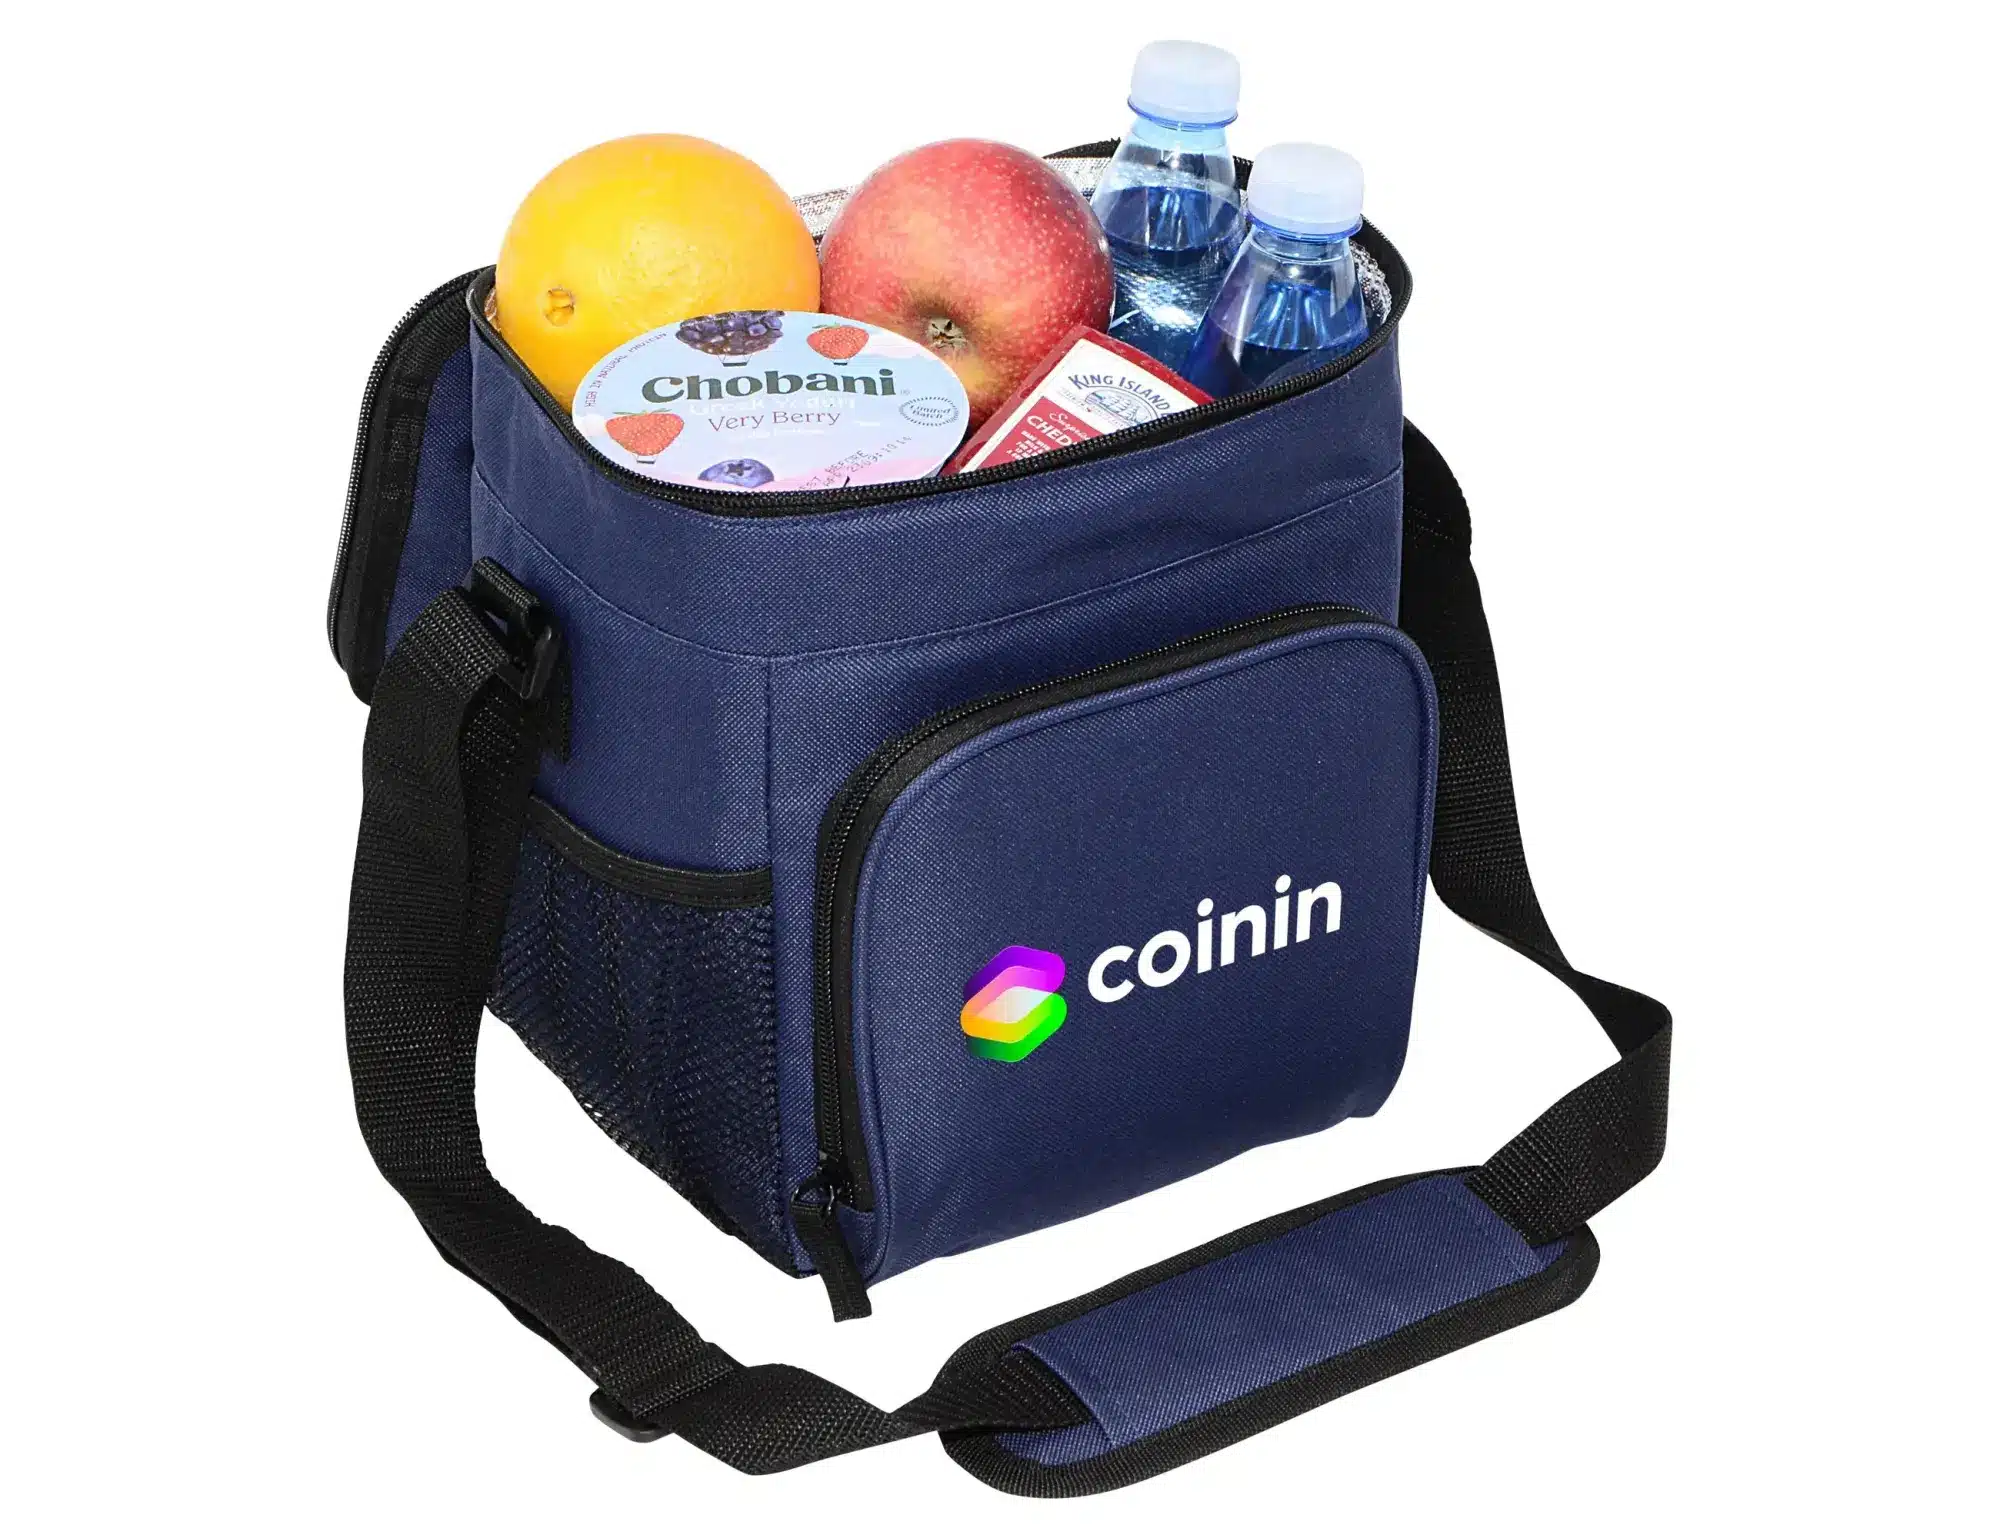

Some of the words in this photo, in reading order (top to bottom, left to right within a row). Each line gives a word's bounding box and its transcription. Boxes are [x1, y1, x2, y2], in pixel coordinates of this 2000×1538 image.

[641, 368, 897, 403] Chobani
[1068, 374, 1114, 390] KING
[1119, 376, 1170, 412] ISLAND
[708, 415, 764, 432] Very
[773, 411, 841, 426] Berry
[1087, 874, 1342, 1003] coinin
